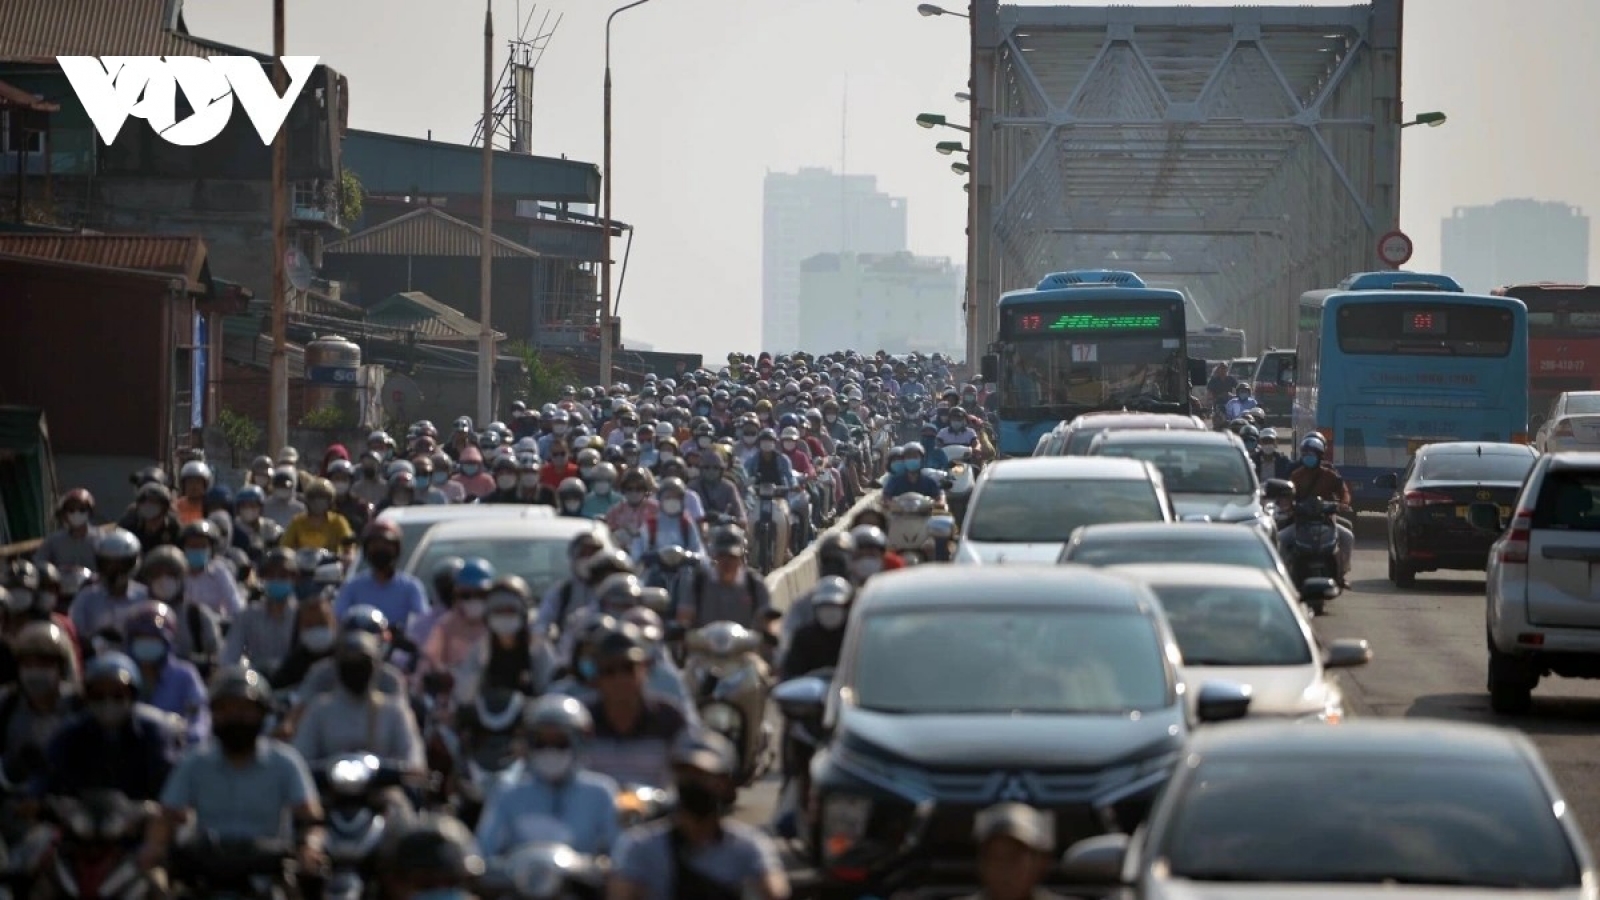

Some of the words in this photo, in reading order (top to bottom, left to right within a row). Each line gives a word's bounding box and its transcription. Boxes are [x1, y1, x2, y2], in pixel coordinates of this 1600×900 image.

[1023, 315, 1040, 329] 17
[1414, 314, 1432, 328] 01
[1076, 344, 1092, 361] 17
